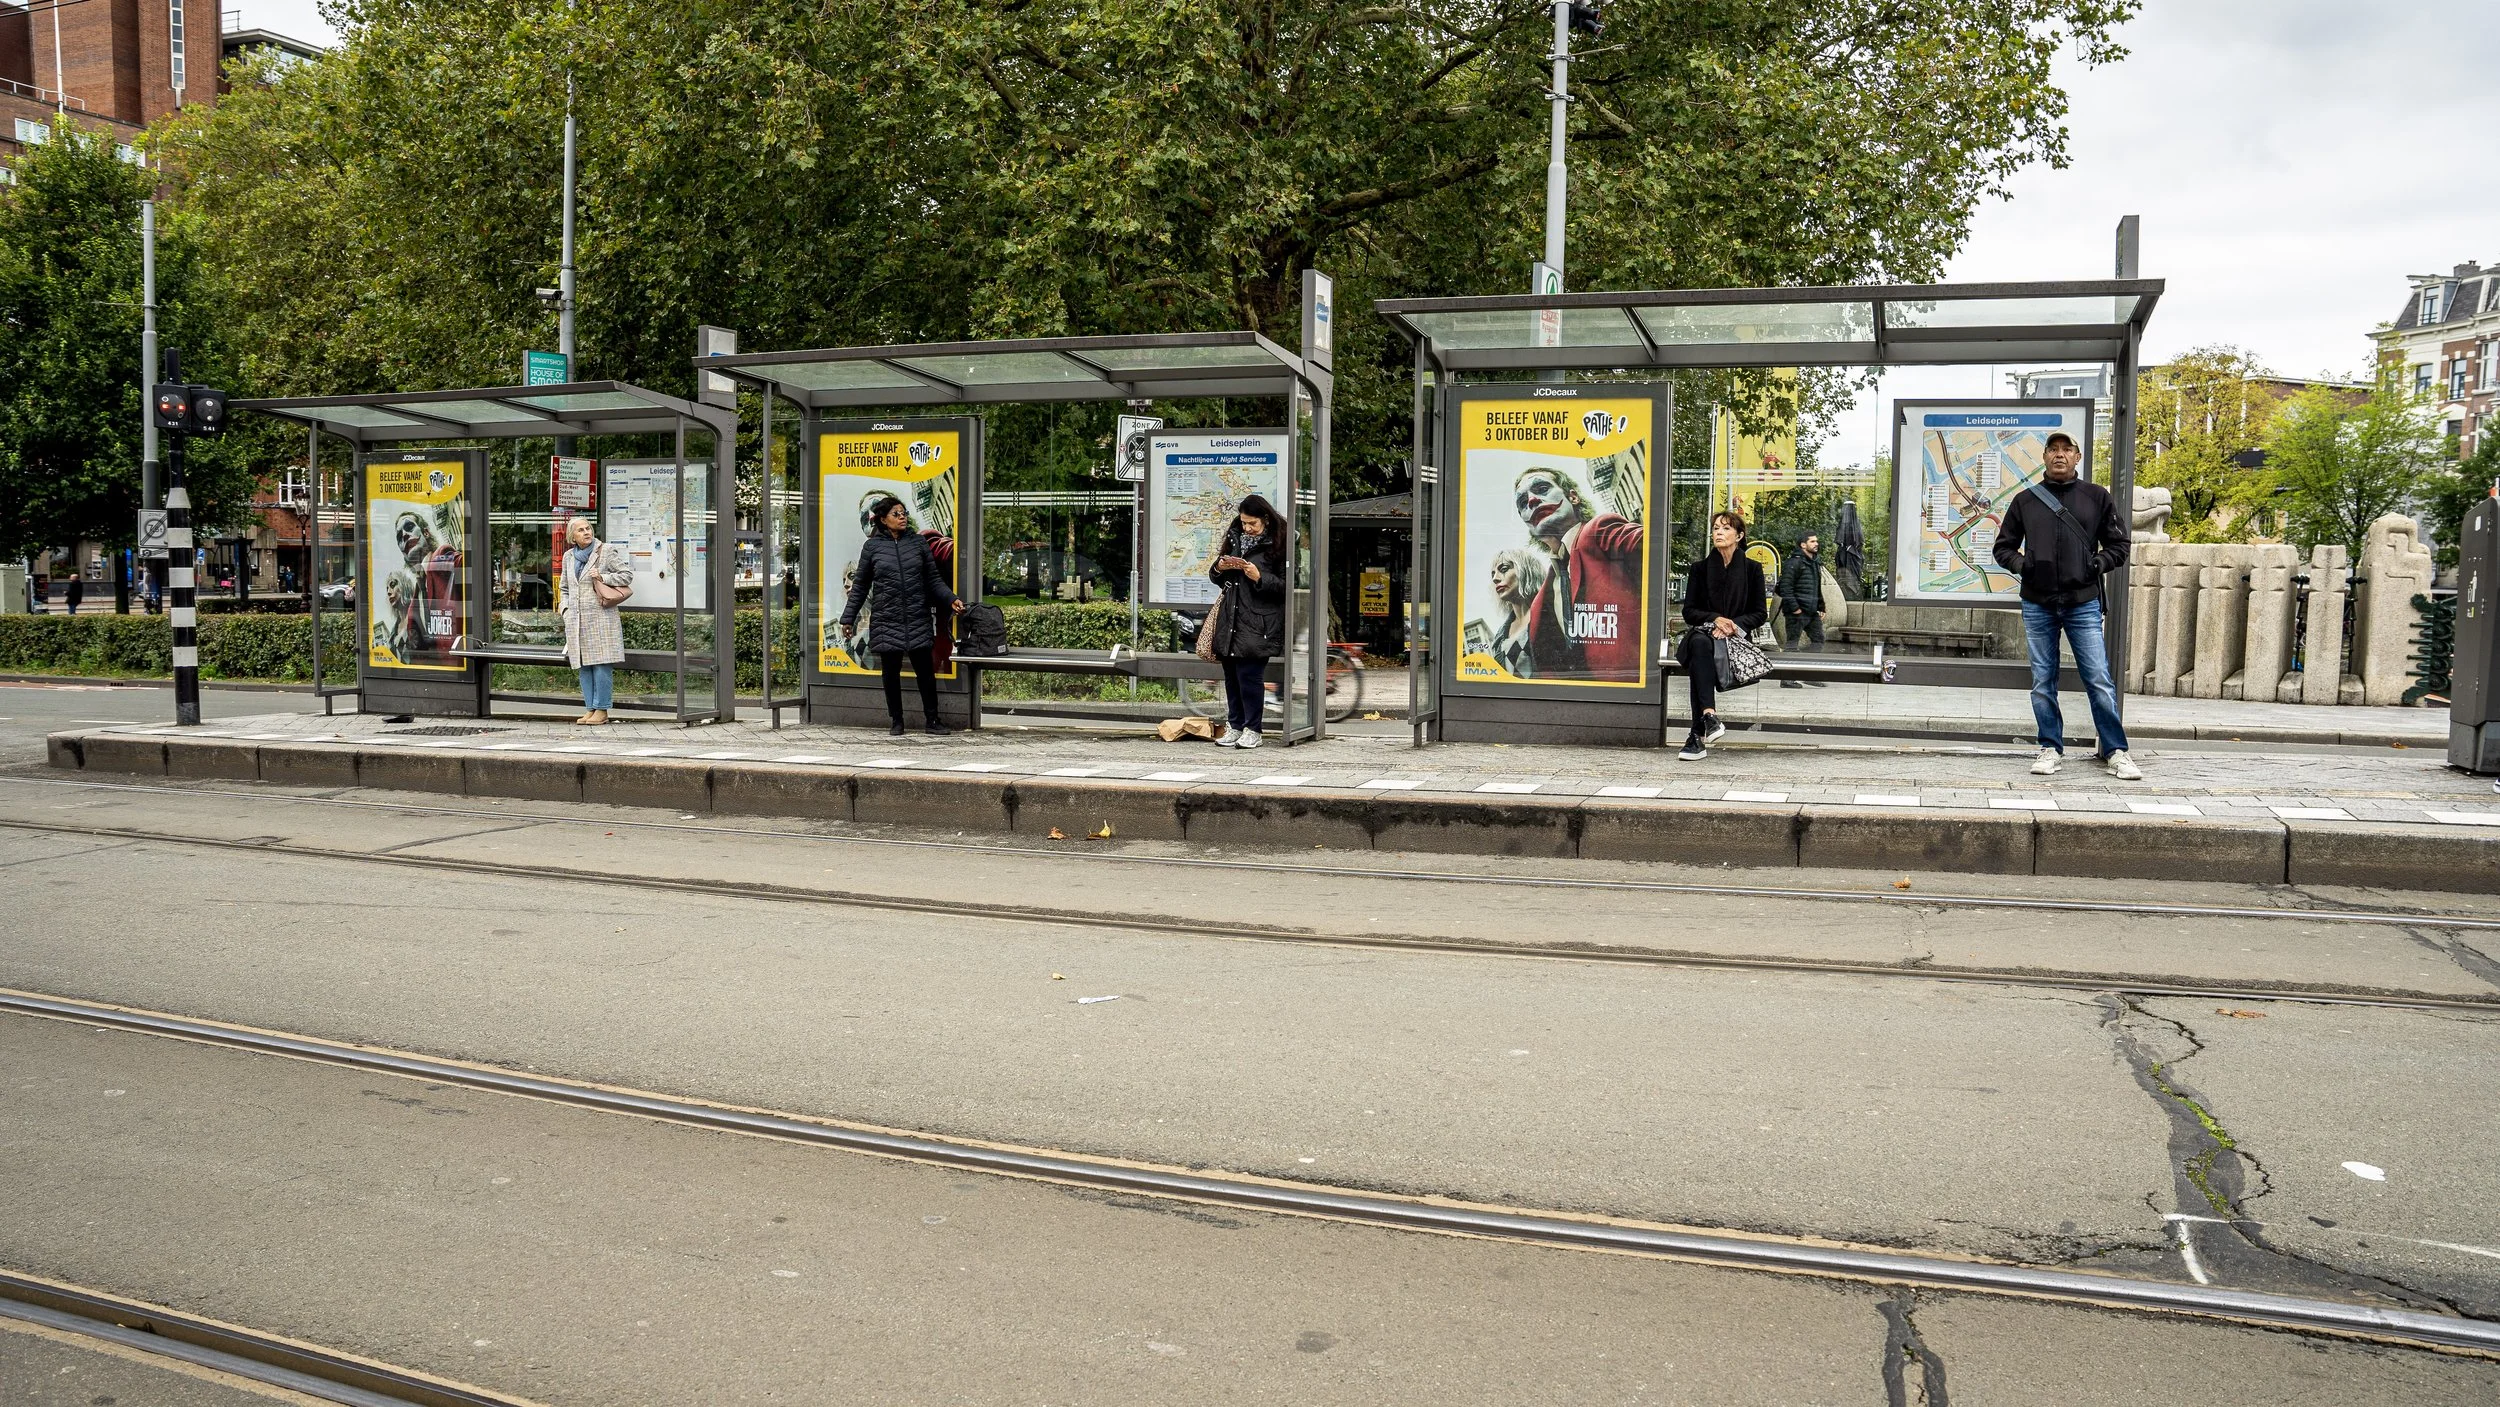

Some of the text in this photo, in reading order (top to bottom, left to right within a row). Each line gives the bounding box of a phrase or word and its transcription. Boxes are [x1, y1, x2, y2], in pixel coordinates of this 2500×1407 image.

[530, 357, 565, 366] SMARTSHOP
[530, 369, 564, 379] HOUSE OF
[1533, 388, 1577, 397] JCDecaux
[1486, 411, 1569, 425] BELEEF VANAF
[1966, 416, 2019, 425] Leidseplein
[871, 423, 904, 431] JCDecaux
[1485, 428, 1569, 441] 3 OKTOBER BIJ
[838, 442, 898, 454] BELEEF VANAF
[1210, 438, 1261, 448] Leidseplein
[837, 456, 899, 467] 3 OKTOBER BIJ
[1178, 456, 1214, 464] Nachtlijnen
[380, 471, 422, 481] BELEEF VANAF
[380, 483, 422, 493] 3 OKTOBER BIJ
[1574, 603, 1618, 612] PHOENIX GAGA
[427, 616, 453, 635] JOKER
[1568, 612, 1618, 639] JOKER
